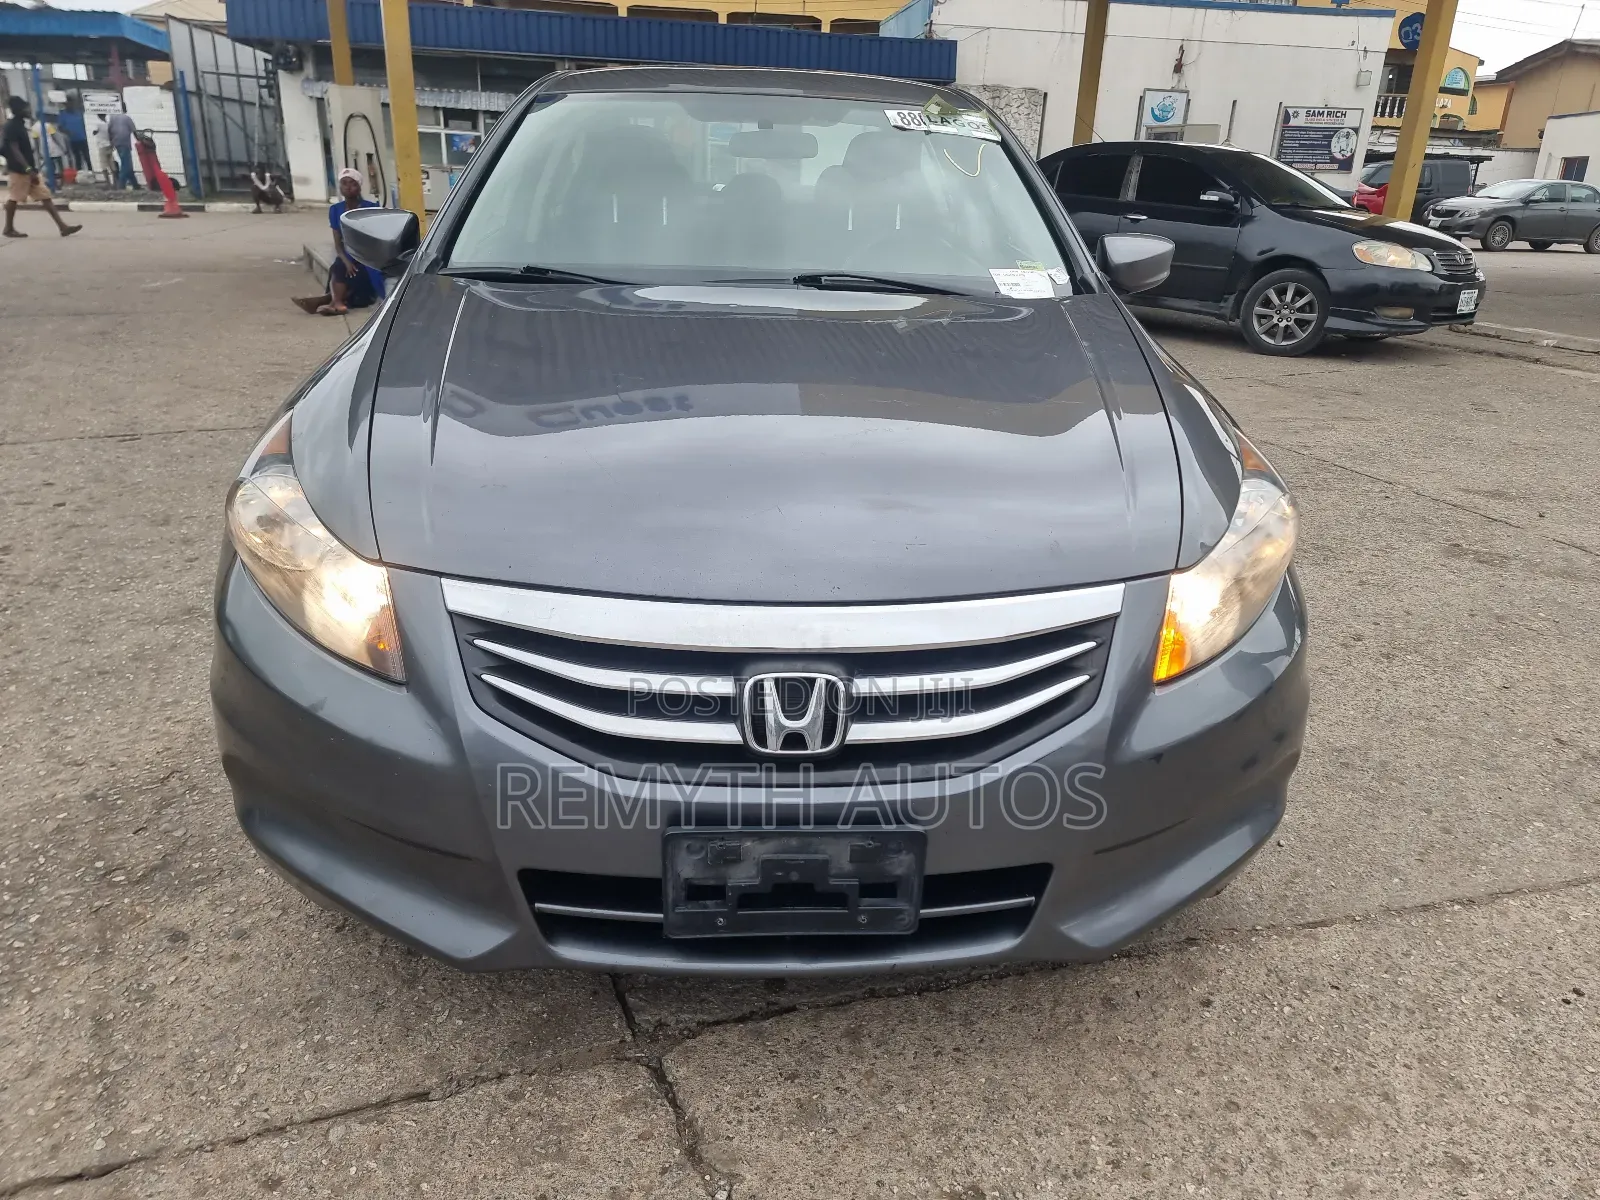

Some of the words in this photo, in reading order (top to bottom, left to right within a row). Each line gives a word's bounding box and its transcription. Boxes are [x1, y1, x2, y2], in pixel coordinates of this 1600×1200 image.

[1304, 110, 1325, 118] SAM
[1326, 110, 1347, 119] RICH
[926, 114, 993, 133] LAGOS
